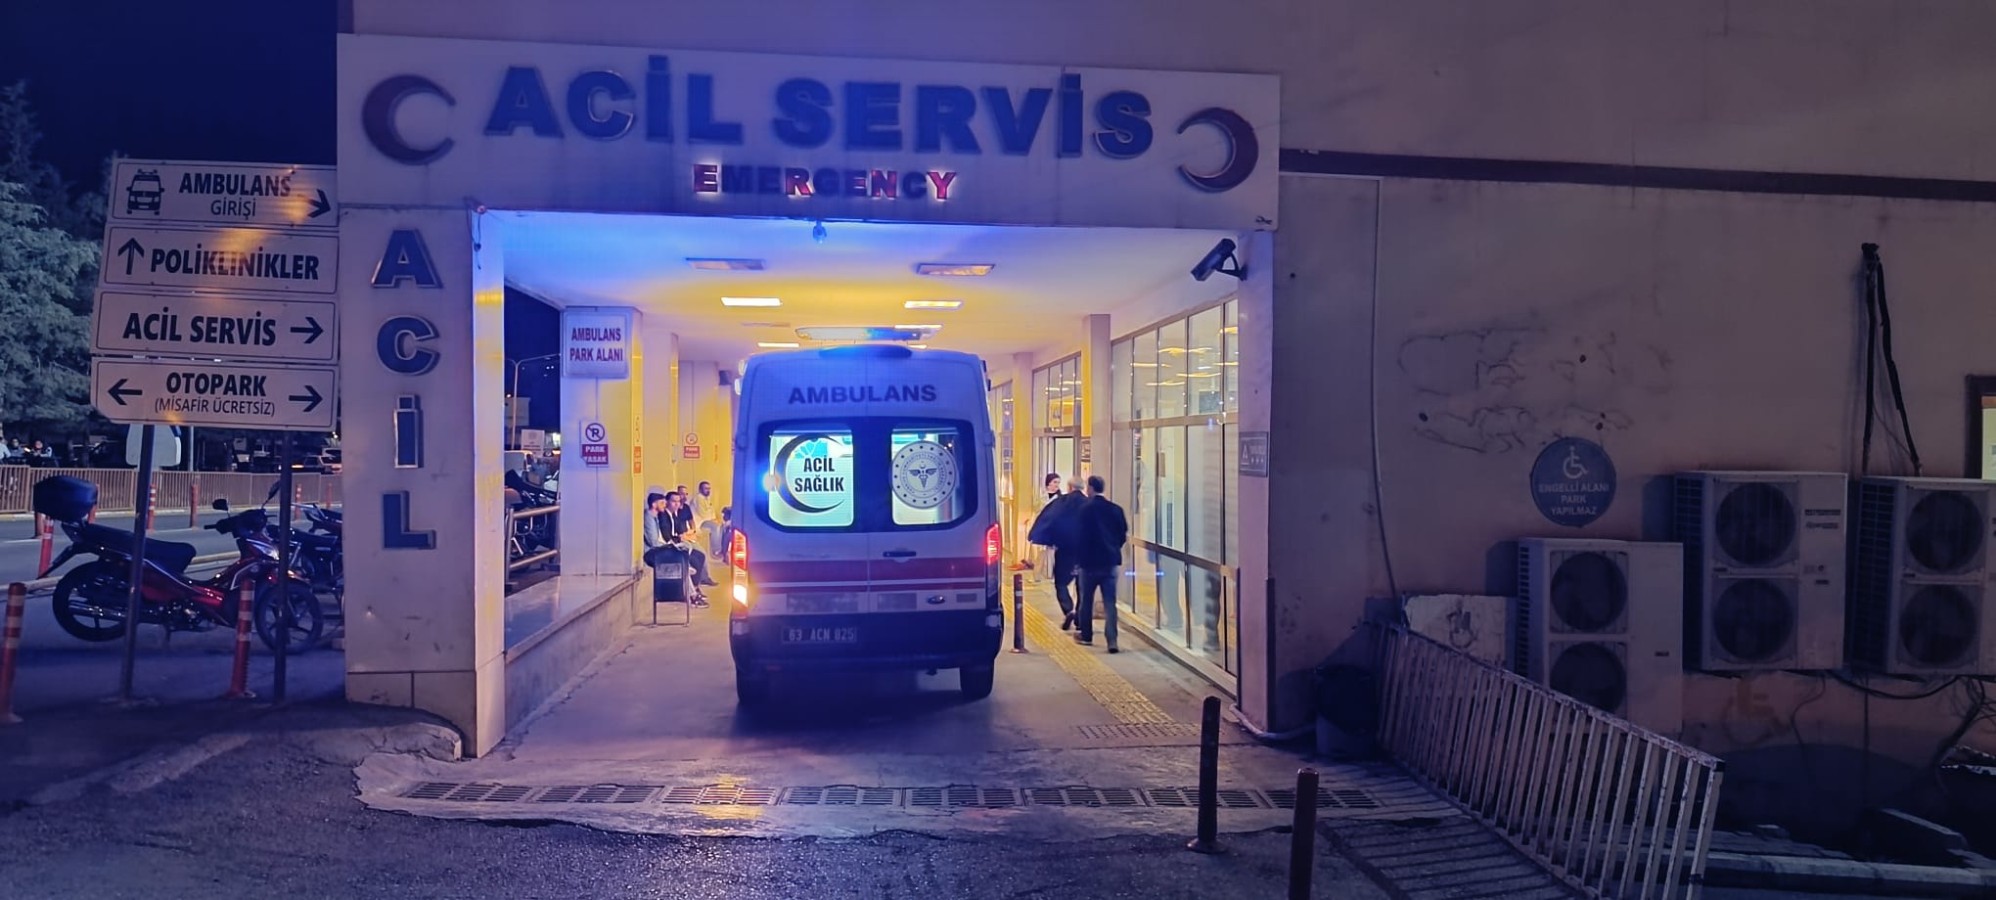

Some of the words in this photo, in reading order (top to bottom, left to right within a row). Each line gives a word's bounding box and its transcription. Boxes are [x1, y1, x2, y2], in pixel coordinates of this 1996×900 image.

[484, 54, 744, 146] ACİL
[772, 73, 1154, 159] SERVİS
[178, 172, 291, 197] AMBULANS
[692, 163, 957, 200] EMERGENCY
[210, 199, 257, 220] GİRİŞİ
[150, 243, 320, 280] POLİKLİNİKLER
[122, 306, 182, 342] ACİL
[189, 311, 277, 346] SERVİS
[571, 327, 621, 342] AMBULANS
[569, 347, 593, 361] PARK
[596, 348, 623, 362] ALANI
[165, 371, 268, 397] OTOPARK
[788, 384, 937, 405] AMBULANS
[154, 396, 210, 416] (MİSAFİR
[212, 396, 276, 418] ÜCRETSİZ)
[585, 445, 605, 453] PARK
[803, 454, 835, 473] ACİL
[794, 474, 845, 493] SAĞLIK
[1538, 481, 1578, 492] ENGELLİ
[1581, 483, 1609, 492] ALANI
[1561, 495, 1586, 503] PARK
[1551, 506, 1597, 515] YAPILMAZ
